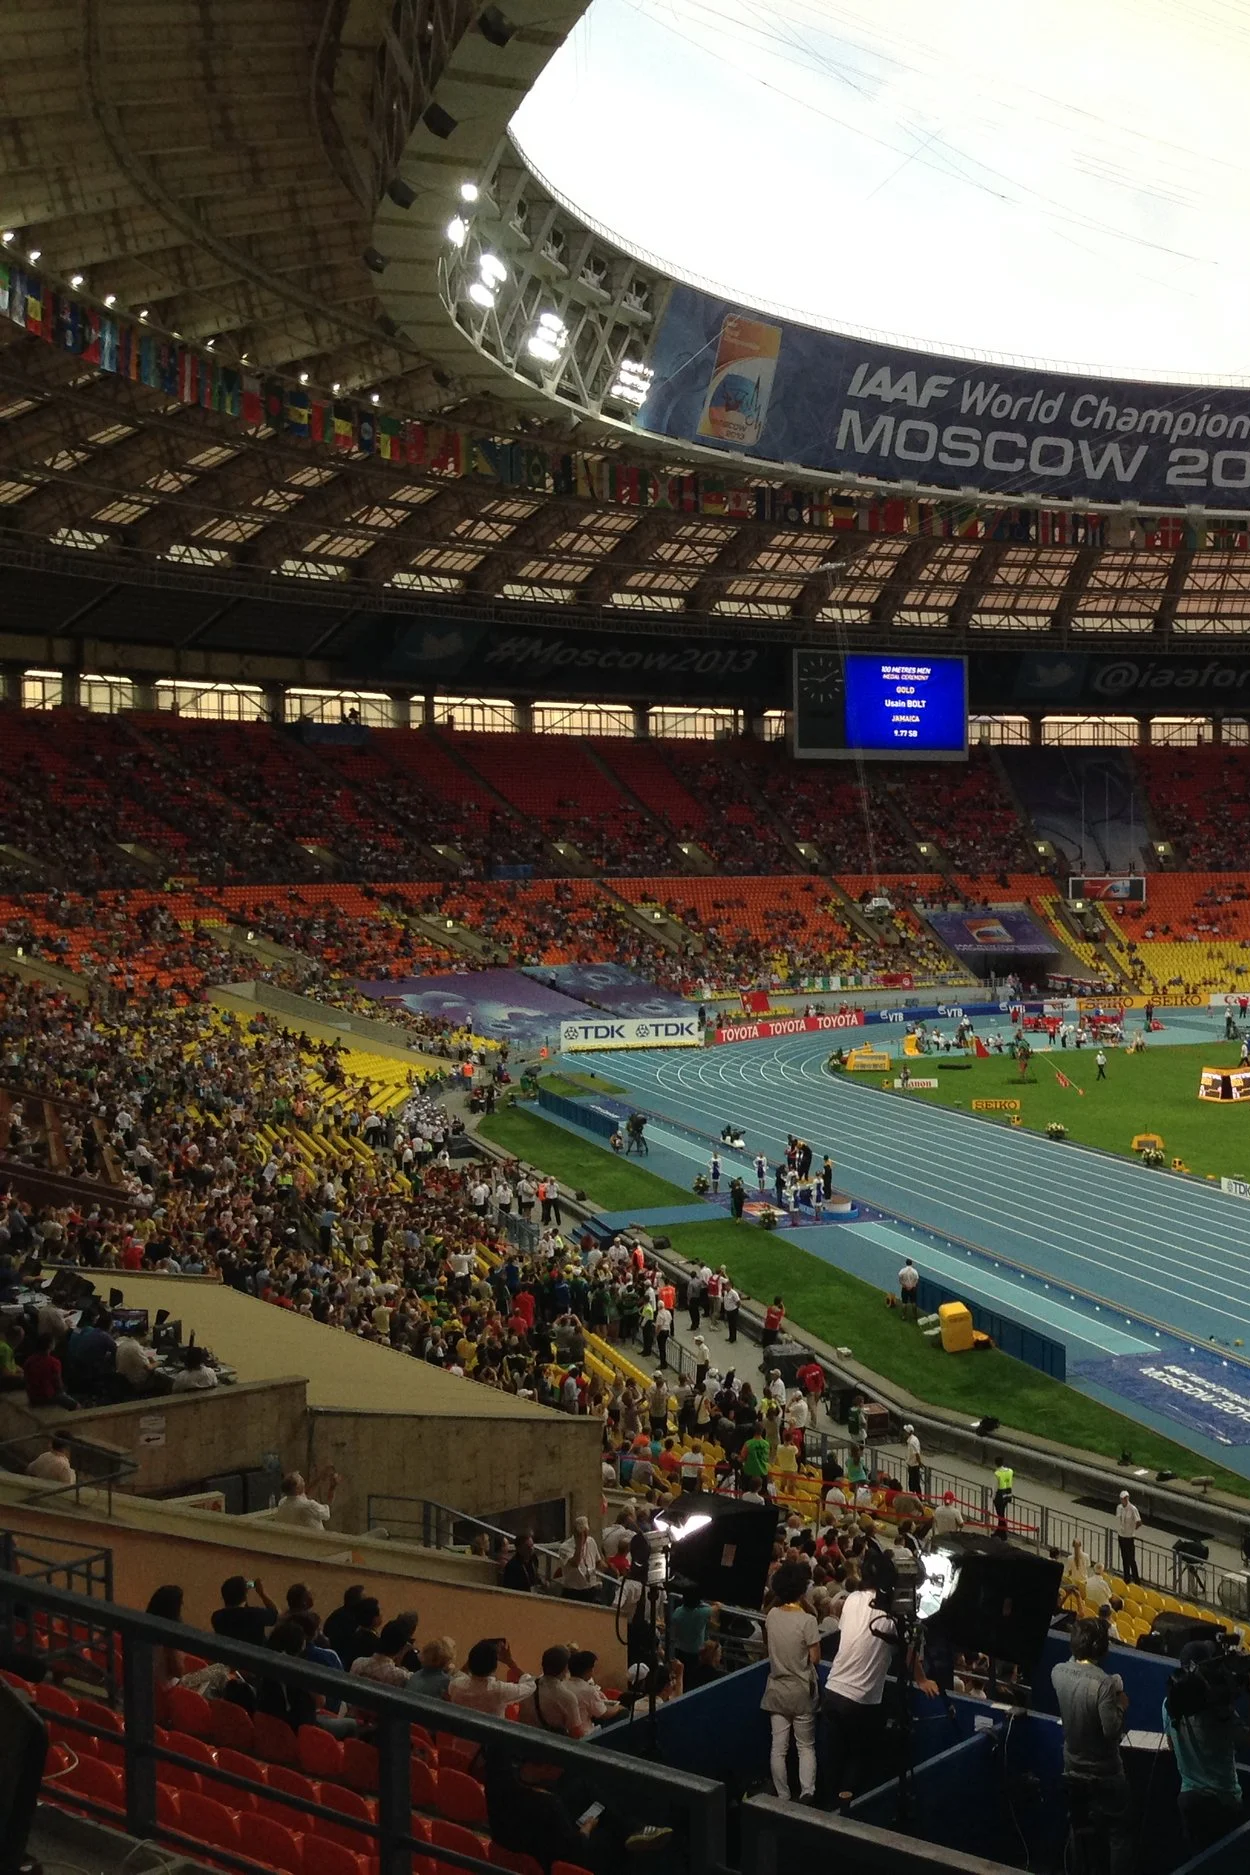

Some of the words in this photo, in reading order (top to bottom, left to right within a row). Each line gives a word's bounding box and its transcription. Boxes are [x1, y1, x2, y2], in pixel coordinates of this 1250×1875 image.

[847, 363, 956, 408] IAAF
[960, 380, 1066, 424] World
[835, 408, 1149, 482] MOSCOW
[484, 635, 758, 674] #Moscow2013
[896, 686, 915, 694] GOLD
[885, 699, 906, 708] Usain
[907, 700, 926, 708] BOLT
[892, 715, 920, 723] JAMAICA
[1151, 995, 1202, 1007] SEIKO
[888, 1012, 904, 1022] VTB
[946, 1007, 963, 1018] VTB
[769, 1019, 806, 1036] TOYOTA
[817, 1014, 858, 1029] TOYOTA
[579, 1025, 625, 1039] TDK
[649, 1023, 694, 1036] TDK
[721, 1026, 759, 1042] TOYOTA
[974, 1100, 1018, 1109] SEIKO
